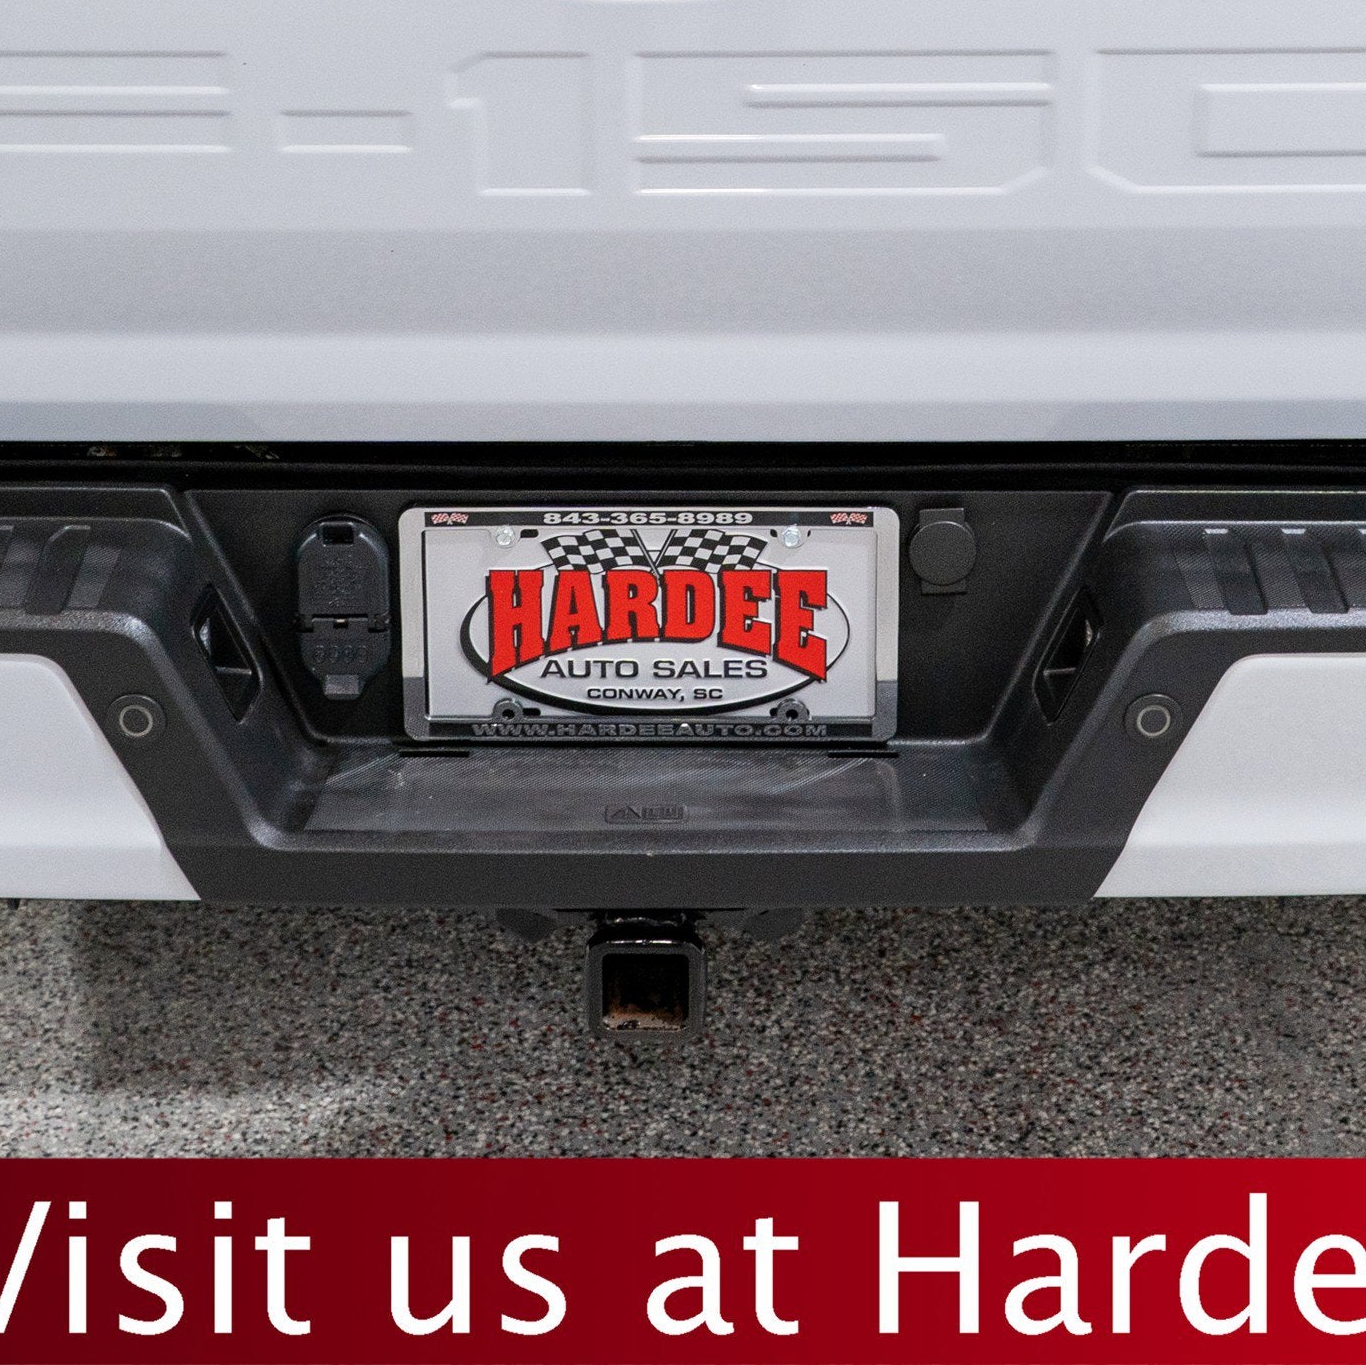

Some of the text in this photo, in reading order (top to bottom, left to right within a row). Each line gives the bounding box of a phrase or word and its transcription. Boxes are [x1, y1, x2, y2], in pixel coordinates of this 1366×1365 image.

[543, 511, 753, 525] 843-365-8989
[486, 569, 828, 682] HARDEE
[540, 659, 769, 679] AUTO SALES
[586, 687, 724, 702] CONWAY, SC
[471, 722, 828, 737] WWW.HARDEEAUTO.COM
